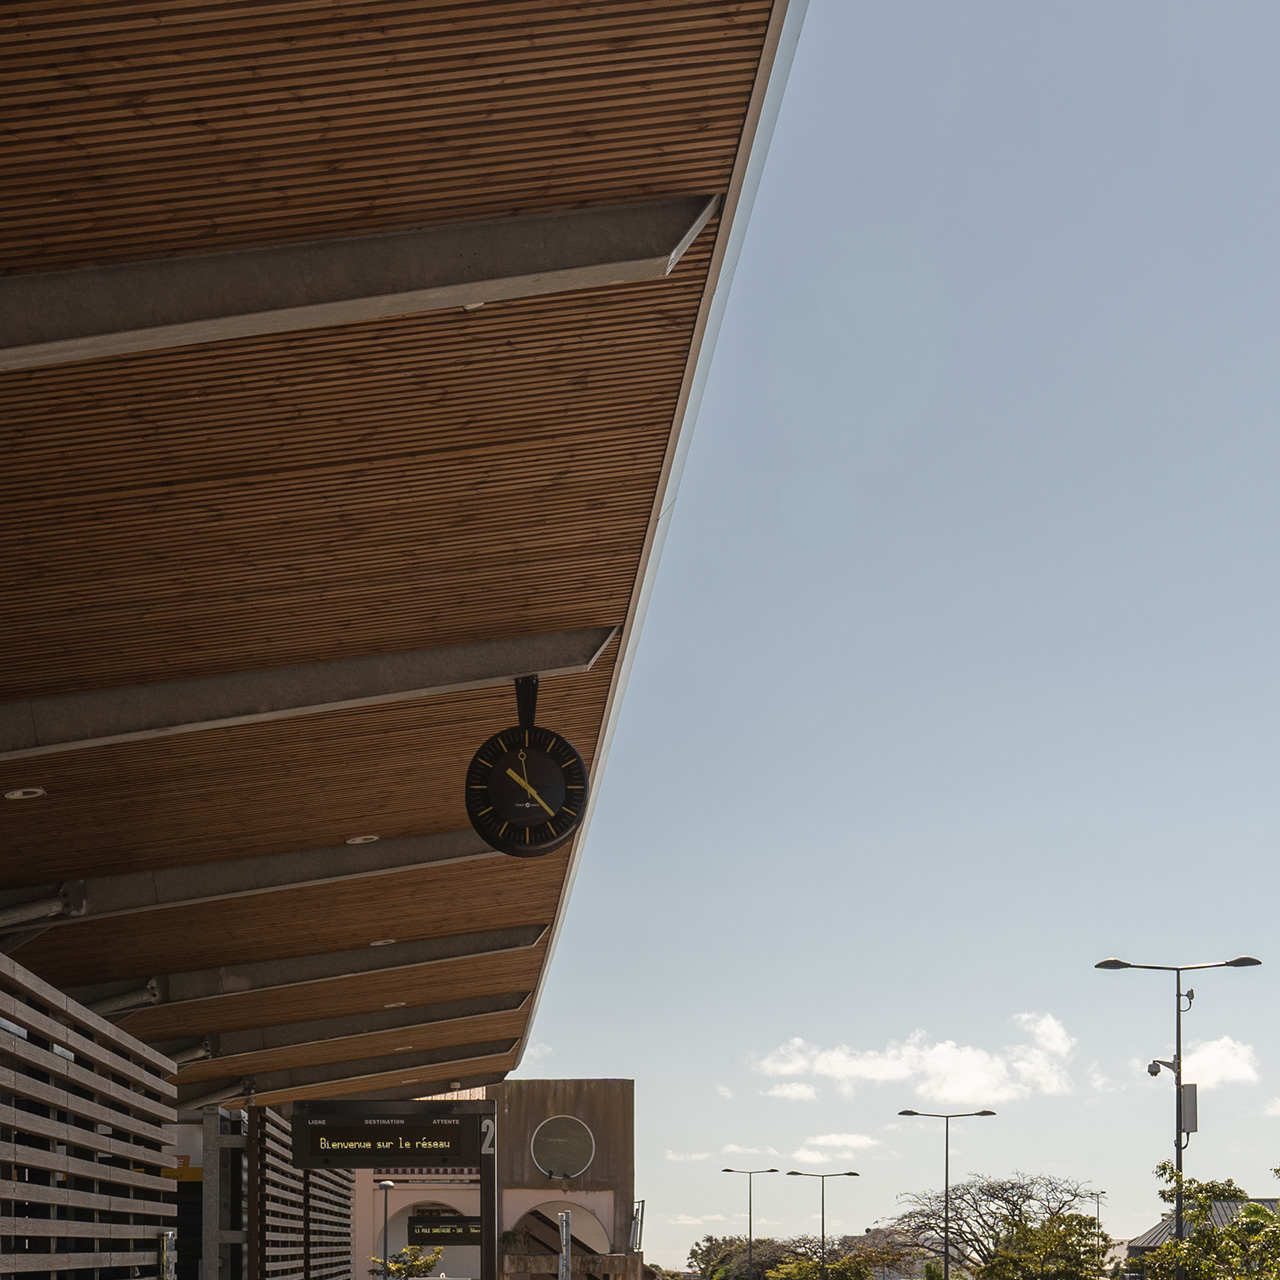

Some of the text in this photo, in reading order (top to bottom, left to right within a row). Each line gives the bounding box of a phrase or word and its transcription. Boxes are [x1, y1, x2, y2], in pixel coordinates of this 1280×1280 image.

[320, 1137, 450, 1149] Bienvenue sur le réseau
[481, 1119, 495, 1154] 2
